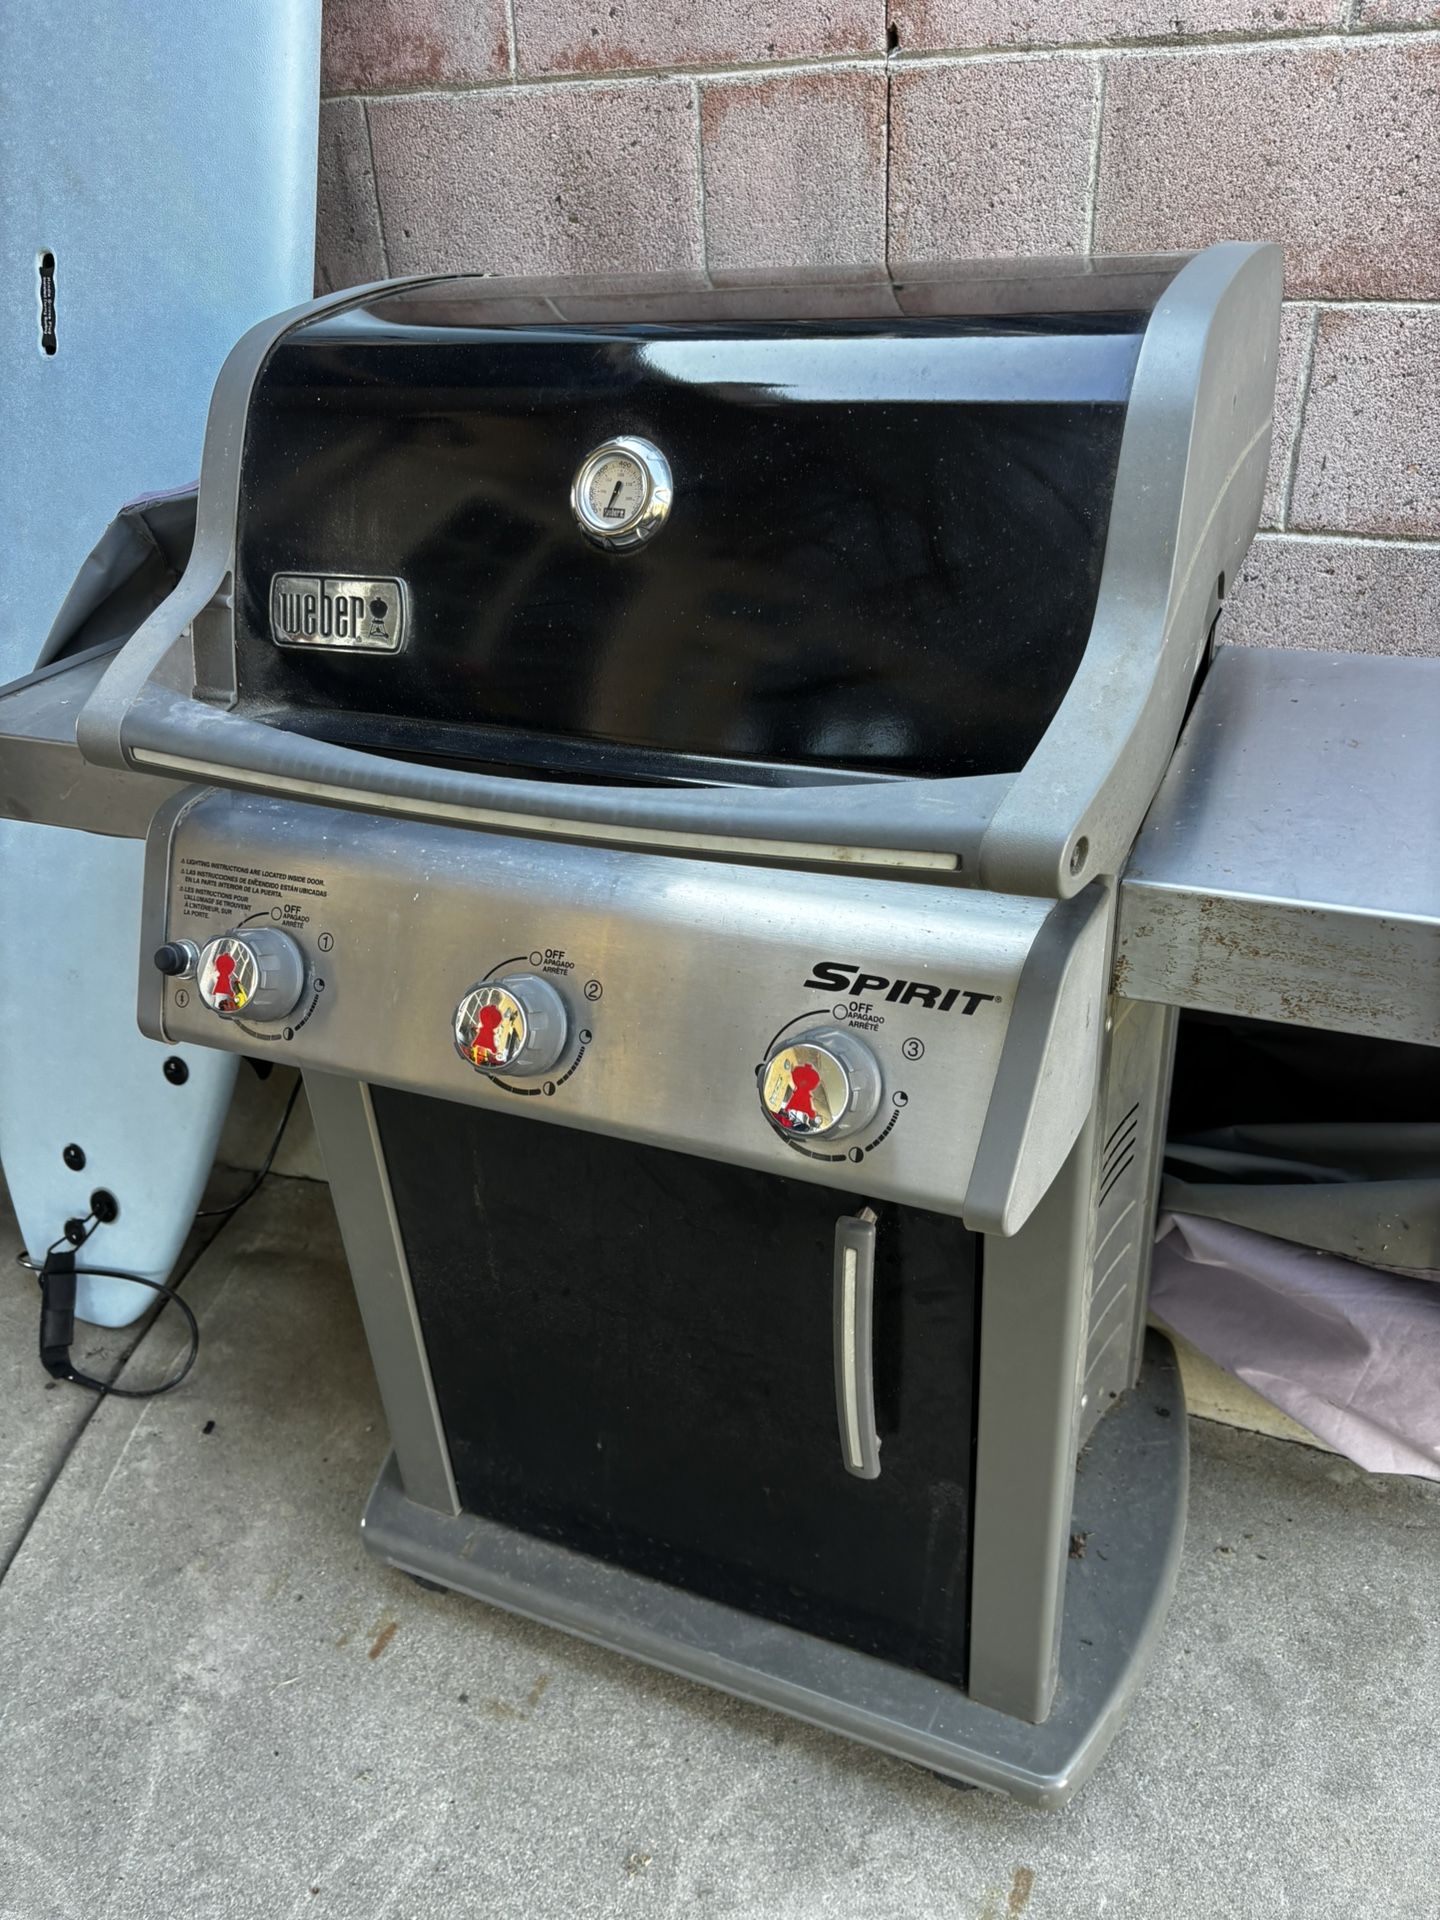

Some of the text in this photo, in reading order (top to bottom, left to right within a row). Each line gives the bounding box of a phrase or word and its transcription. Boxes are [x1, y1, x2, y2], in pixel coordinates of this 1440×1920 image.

[279, 578, 365, 639] weber
[186, 858, 210, 868] LIGHTING
[211, 862, 248, 874] INSTRUCTIONS
[250, 868, 261, 876] ARE
[262, 871, 287, 880] LOCATED
[288, 875, 306, 883] INSIDE
[197, 871, 238, 882] INSTRUCCIONES
[280, 884, 298, 892] ESTÁN
[299, 888, 327, 898] UBICADAS
[201, 879, 217, 887] PARTE
[218, 882, 242, 891] INTERIOR
[195, 888, 232, 899] INSTRUCTIONS
[224, 901, 252, 911] TROUVENT
[284, 904, 302, 914] OFF
[283, 913, 310, 922] APAGADO
[282, 920, 304, 928] ARRÊTÉ
[545, 949, 565, 959] OFF
[543, 958, 575, 969] APAGADO
[542, 966, 568, 976] ARRÊTÉ
[849, 1002, 873, 1013] OFF
[848, 1012, 885, 1024] APAGADO
[848, 1020, 880, 1032] ARRÊTÉ
